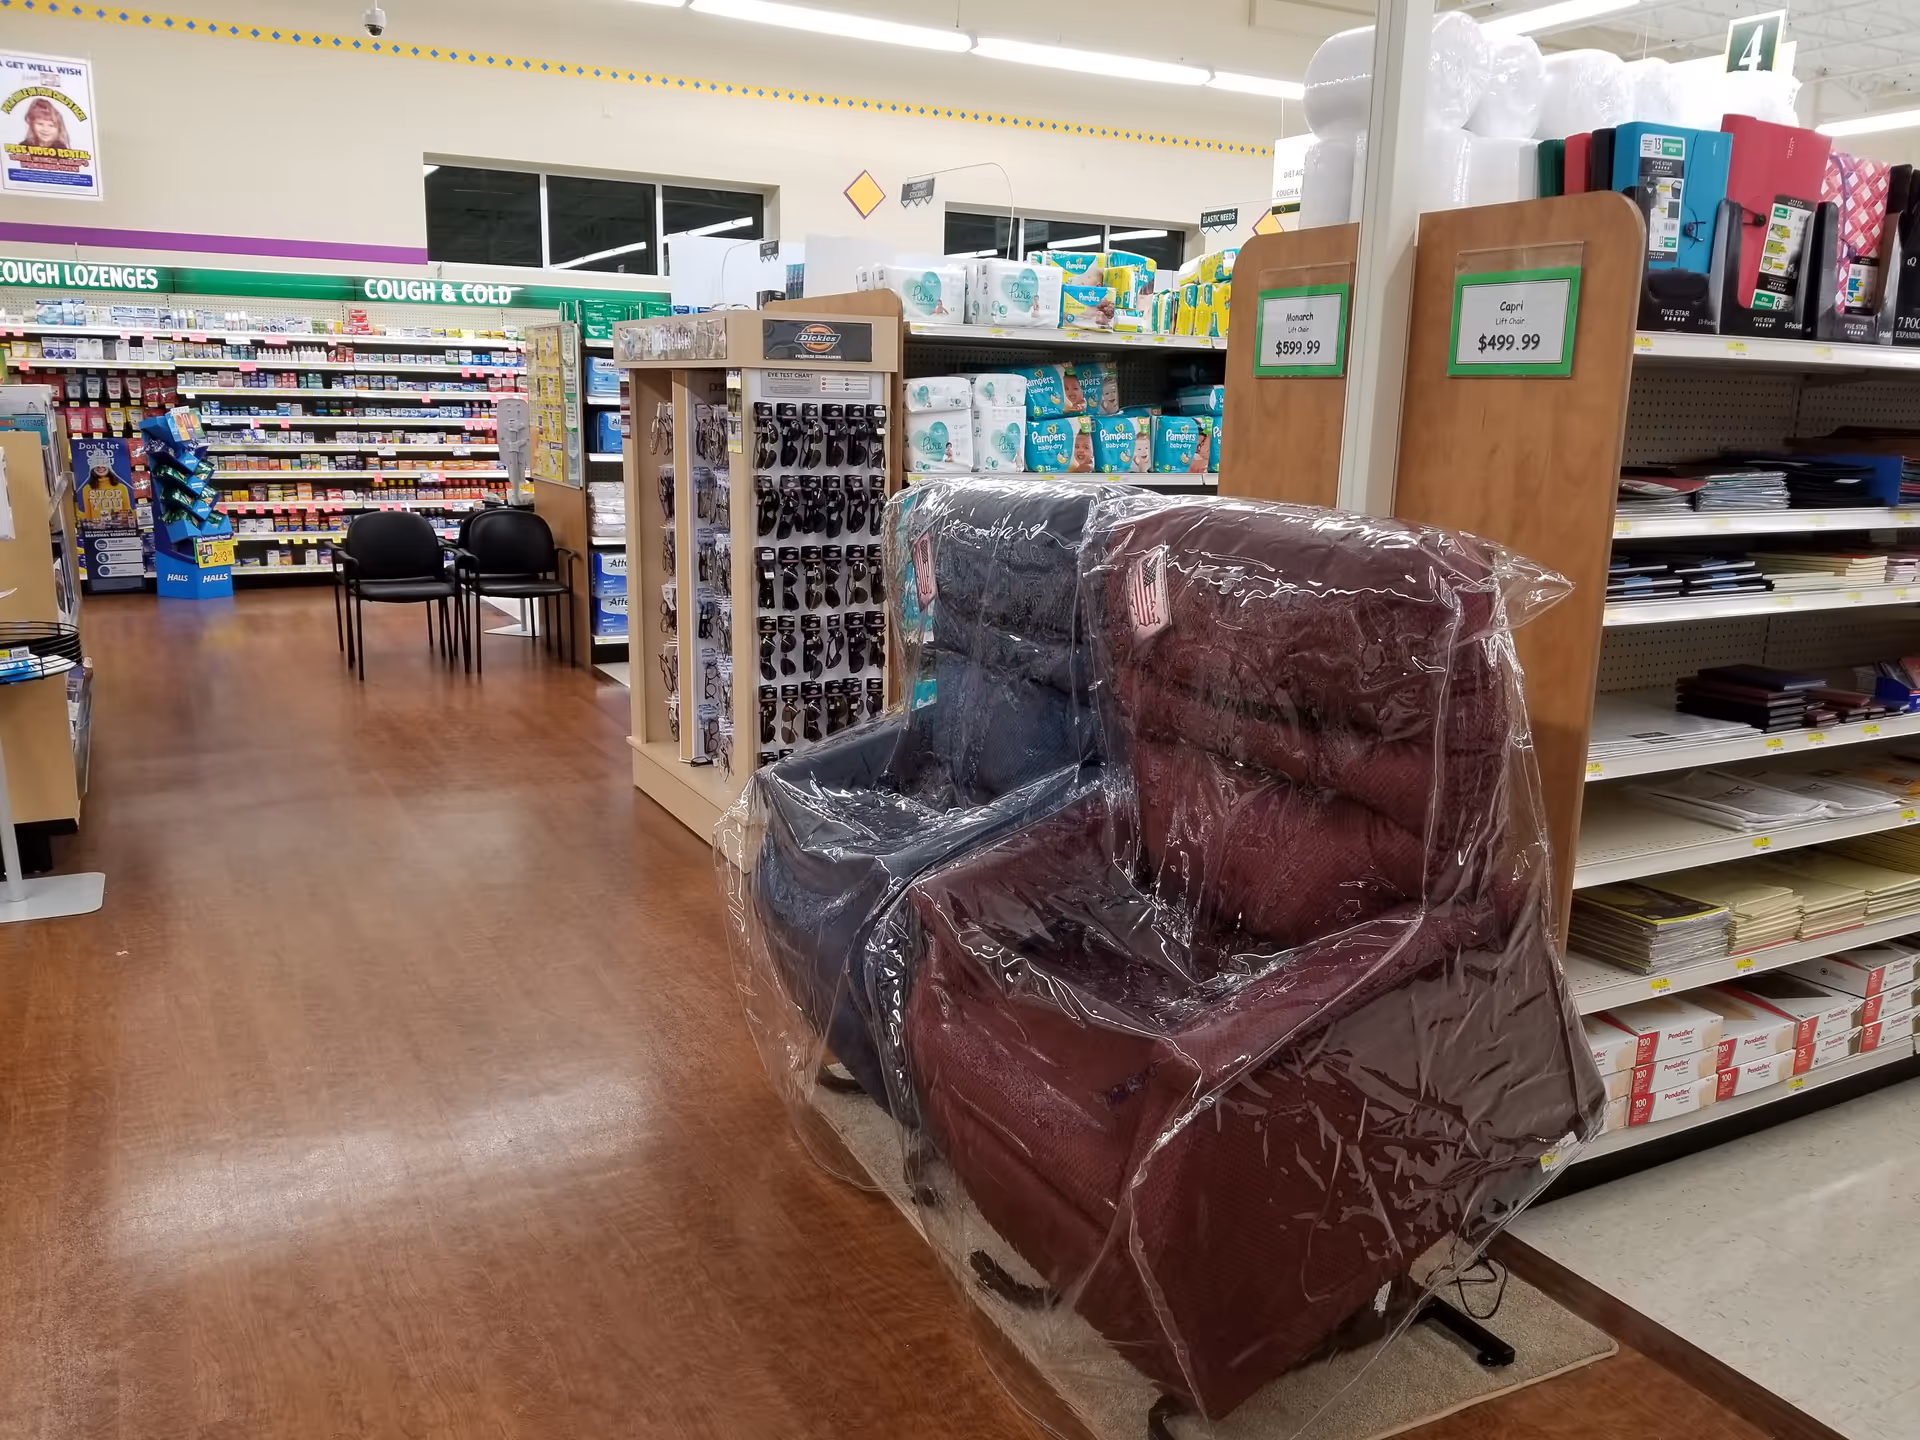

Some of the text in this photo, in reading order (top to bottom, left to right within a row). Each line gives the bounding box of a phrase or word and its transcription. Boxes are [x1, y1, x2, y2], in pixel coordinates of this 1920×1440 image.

[1738, 24, 1764, 70] 4
[6, 61, 24, 69] GET
[27, 63, 54, 72] WELL
[56, 66, 82, 76] WISH
[4, 143, 91, 160] FREE VIDEO RENTAL
[1284, 170, 1295, 178] DIET
[1276, 188, 1294, 197] COUGH
[1203, 212, 1236, 223] ELASTIC NEEDS
[1066, 261, 1087, 270] Pampers
[64, 264, 159, 289] LOZENGES
[364, 279, 512, 304] COUGH & COLD
[912, 285, 934, 302] Pure
[1009, 282, 1031, 300] Pure
[1078, 293, 1100, 302] Pampers
[1499, 300, 1524, 314] Capri
[1286, 312, 1314, 322] Monarch
[1898, 317, 1904, 327] 7
[799, 334, 837, 342] Dickies
[1478, 333, 1540, 354] $499.99
[1275, 340, 1321, 357] $599.99
[1031, 386, 1053, 394] baby-dry
[1031, 431, 1066, 444] Pampers
[1100, 429, 1133, 442] Pampers
[1166, 429, 1196, 442] Pampers
[921, 436, 942, 452] Pure
[998, 436, 1015, 450] Pure
[89, 489, 122, 498] STOP
[90, 498, 123, 510] YOU
[213, 552, 219, 563] 2
[223, 551, 228, 562] 3
[167, 574, 188, 582] HALLS
[203, 573, 228, 584] HALLS
[1871, 972, 1877, 980] 25
[1867, 1000, 1874, 1008] 25
[1802, 1022, 1809, 1030] 25
[1866, 1027, 1873, 1035] 25
[1667, 1028, 1695, 1040] Pendaflex
[1744, 1034, 1769, 1045] Pendaflex
[1640, 1038, 1650, 1046] 100
[1719, 1044, 1728, 1052] 100
[1799, 1049, 1806, 1057] 25
[1664, 1059, 1690, 1071] Pendaflex
[1747, 1062, 1771, 1074] Pendaflex
[1636, 1070, 1646, 1079] 100
[1722, 1073, 1731, 1081] 100
[1664, 1087, 1691, 1100] Pendaflex
[1636, 1099, 1646, 1108] 100
